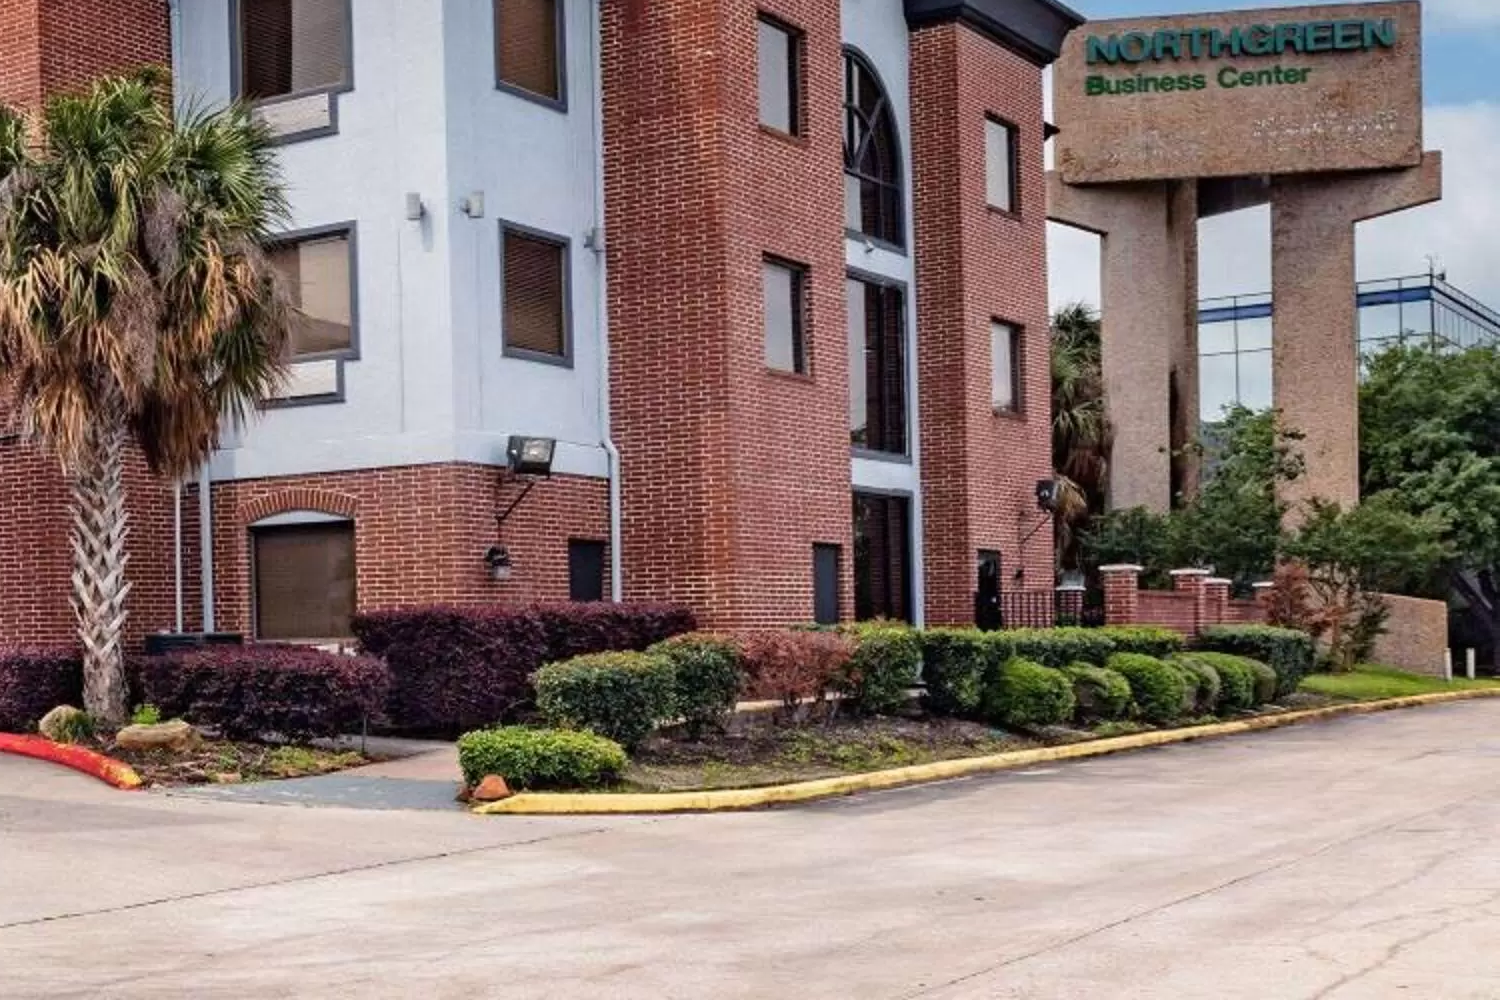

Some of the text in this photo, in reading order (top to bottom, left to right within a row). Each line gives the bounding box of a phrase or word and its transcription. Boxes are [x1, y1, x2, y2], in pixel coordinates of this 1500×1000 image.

[1084, 18, 1397, 65] NORTHGREEN
[1084, 65, 1312, 96] Business Center
